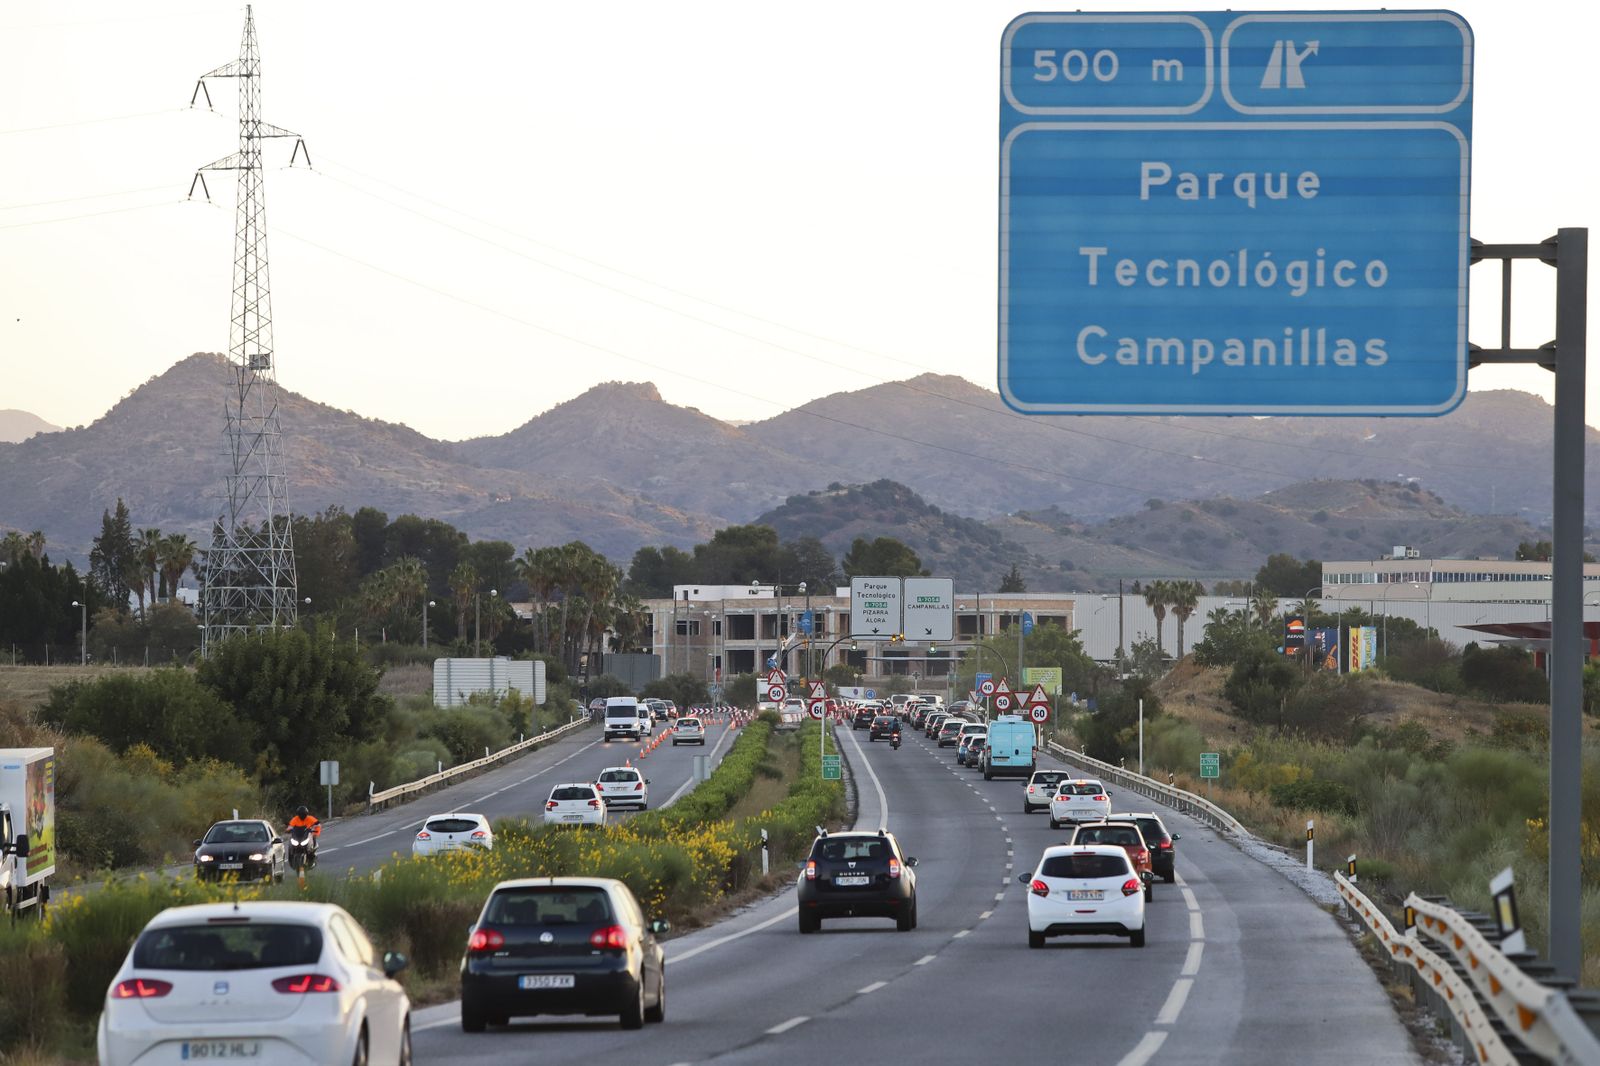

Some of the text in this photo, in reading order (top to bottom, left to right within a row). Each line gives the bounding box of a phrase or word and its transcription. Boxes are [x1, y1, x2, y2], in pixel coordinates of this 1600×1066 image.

[1034, 49, 1183, 82] 500 m
[1140, 161, 1321, 209] Parque
[1079, 246, 1388, 297] Tecnológico
[1076, 325, 1388, 376] Campanillas
[864, 583, 887, 591] Parque
[984, 684, 992, 692] 40
[1034, 709, 1045, 718] 60
[191, 1042, 258, 1058] 9012 HLJ
